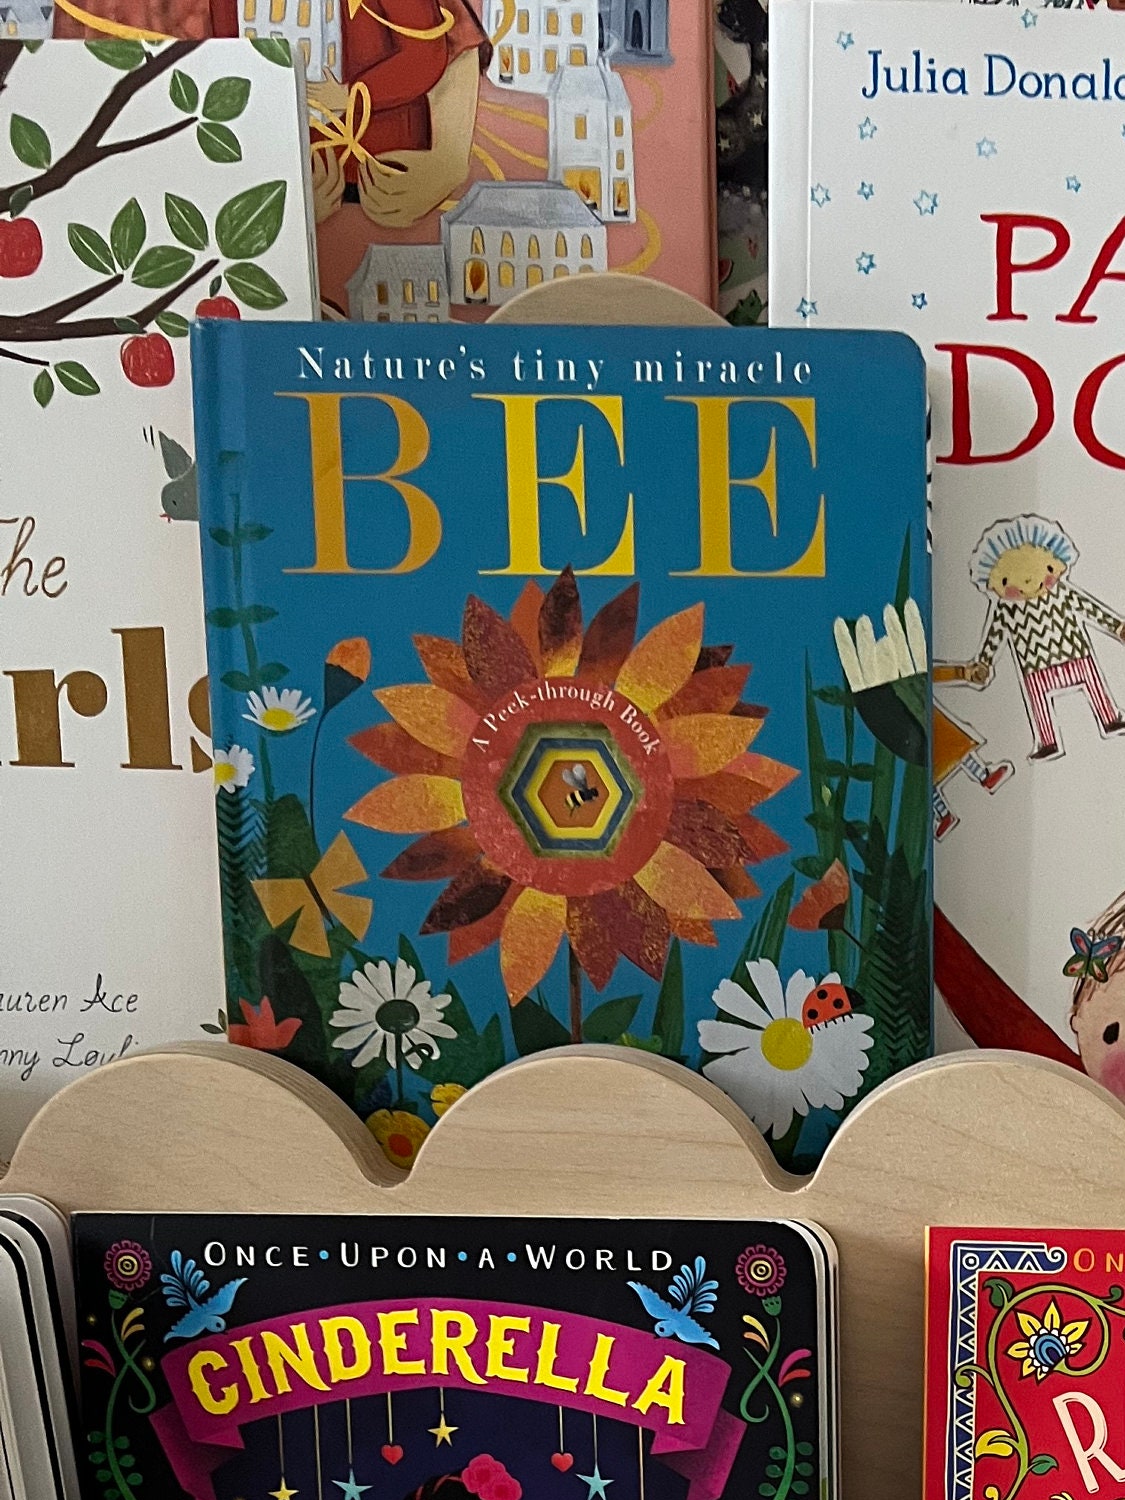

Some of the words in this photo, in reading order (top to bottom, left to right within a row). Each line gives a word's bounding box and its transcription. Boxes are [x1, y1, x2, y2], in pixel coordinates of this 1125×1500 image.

[861, 49, 968, 100] Julia
[296, 346, 486, 381] Nature's
[513, 349, 604, 390] tiny
[633, 351, 812, 384] miracle
[273, 391, 826, 578] BEE
[472, 736, 490, 753] A
[483, 681, 615, 732] Peek-through
[619, 704, 661, 756] Book
[203, 1241, 311, 1268] ONCE
[340, 1242, 447, 1269] UPON
[478, 1247, 495, 1270] A
[525, 1244, 673, 1272] WORLD
[188, 1307, 687, 1425] CINDERELLA
